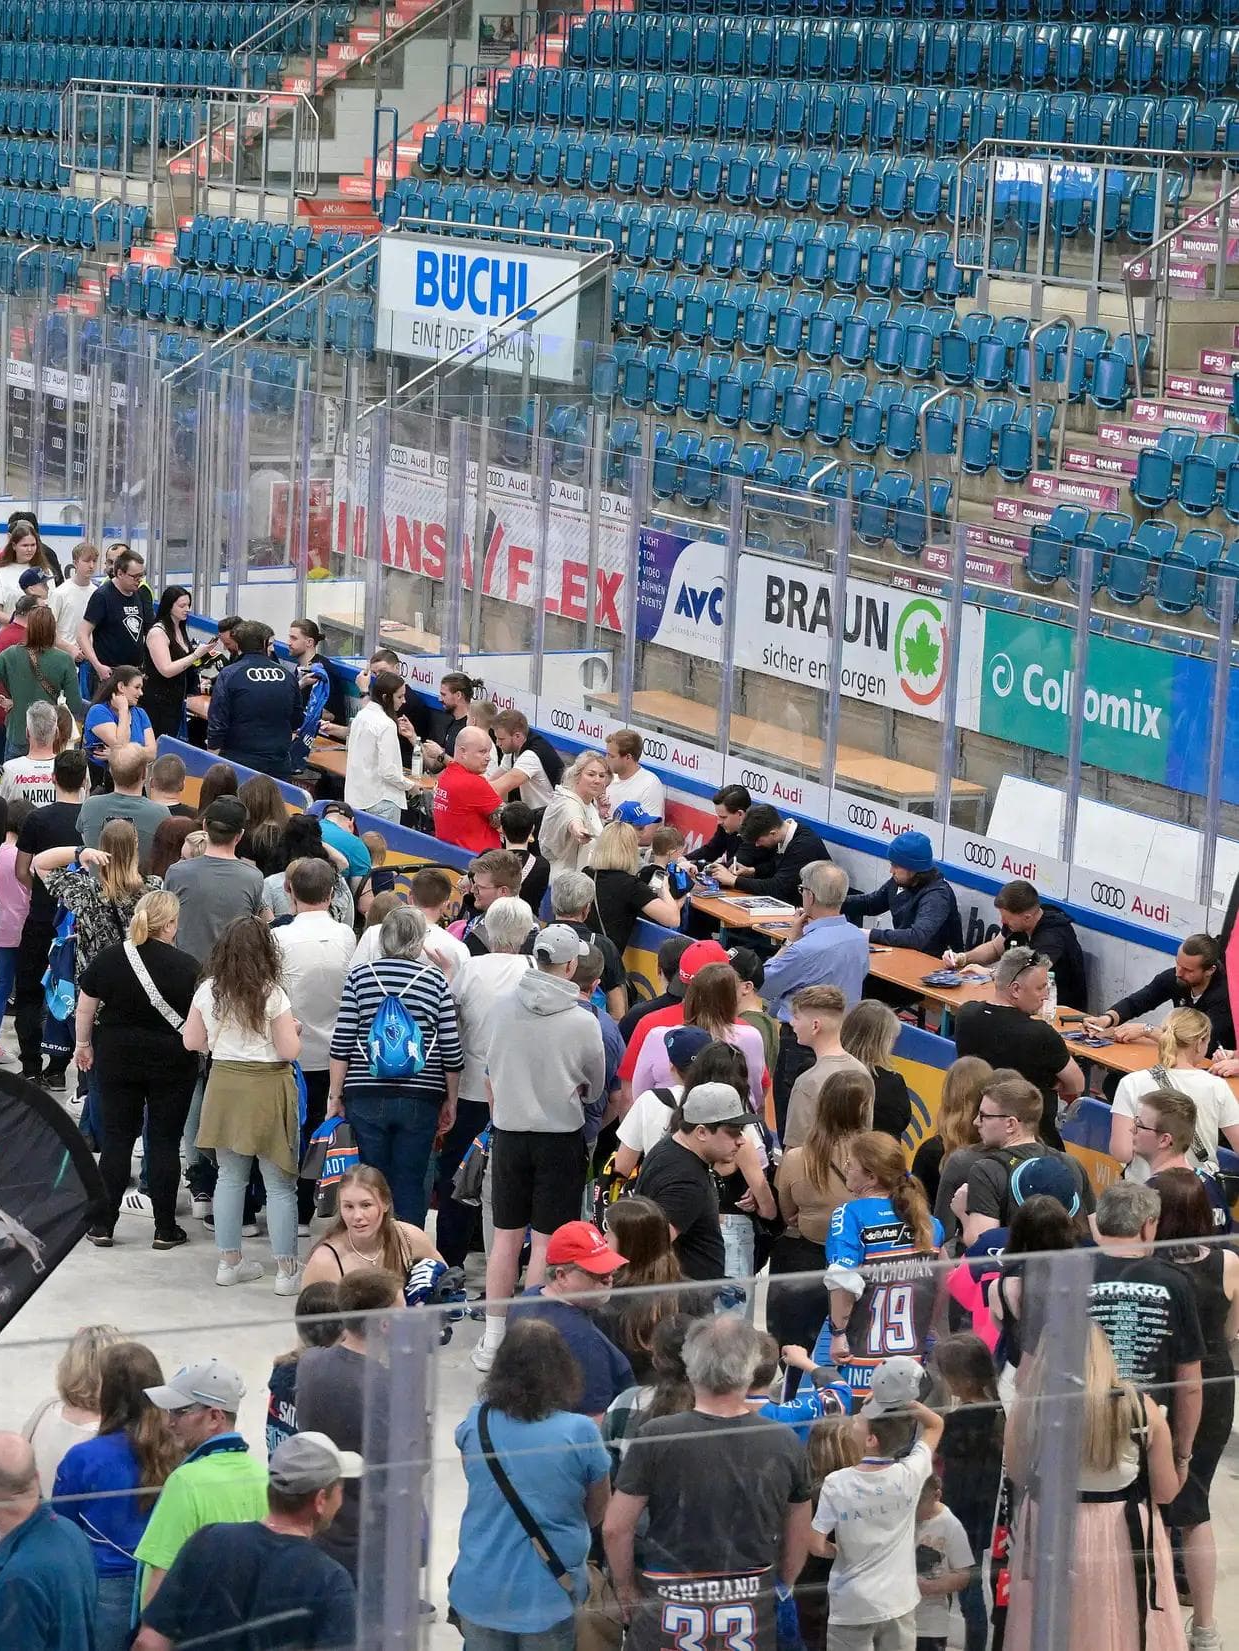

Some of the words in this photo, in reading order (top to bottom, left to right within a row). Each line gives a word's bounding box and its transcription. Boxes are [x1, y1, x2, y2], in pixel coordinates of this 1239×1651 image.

[415, 249, 538, 321] BÜCHL
[411, 320, 441, 346] EINE
[478, 330, 535, 364] ORAUS
[1204, 355, 1223, 367] EFS
[1170, 380, 1190, 393] EFS
[1198, 384, 1226, 398] SMART
[1136, 405, 1156, 417] EFS
[1163, 409, 1208, 425] INNOVATIVE
[1101, 428, 1121, 441] EFS
[410, 455, 429, 470] Audi
[1069, 453, 1088, 465] EFS
[1095, 458, 1123, 472] SMART
[508, 476, 530, 493] Audi
[558, 486, 582, 503] Audi
[1032, 478, 1052, 491] EFS
[1058, 482, 1100, 499] INNOVATIVE
[997, 502, 1016, 514] EFS
[642, 535, 659, 548] LICHT
[989, 535, 1015, 547] SMART
[642, 550, 656, 562] TON
[927, 552, 946, 566] EFS
[641, 565, 661, 579] VIDEO
[507, 544, 625, 632] FEX
[641, 579, 666, 595] BÜHNEN
[640, 596, 663, 610] EVENTS
[673, 580, 726, 627] AVC
[765, 574, 890, 652] BRAUN
[411, 666, 435, 685] Audi
[762, 642, 805, 675] sicher
[809, 660, 887, 698] enorgen
[491, 691, 516, 711] Audi
[1022, 663, 1163, 740] Collomix
[577, 718, 604, 741] Audi
[670, 748, 700, 772] Audi
[772, 781, 803, 806] Audi
[881, 816, 915, 837] Audi
[1001, 855, 1037, 882] Audi
[1131, 895, 1170, 924] Audi
[867, 1283, 917, 1356] 19
